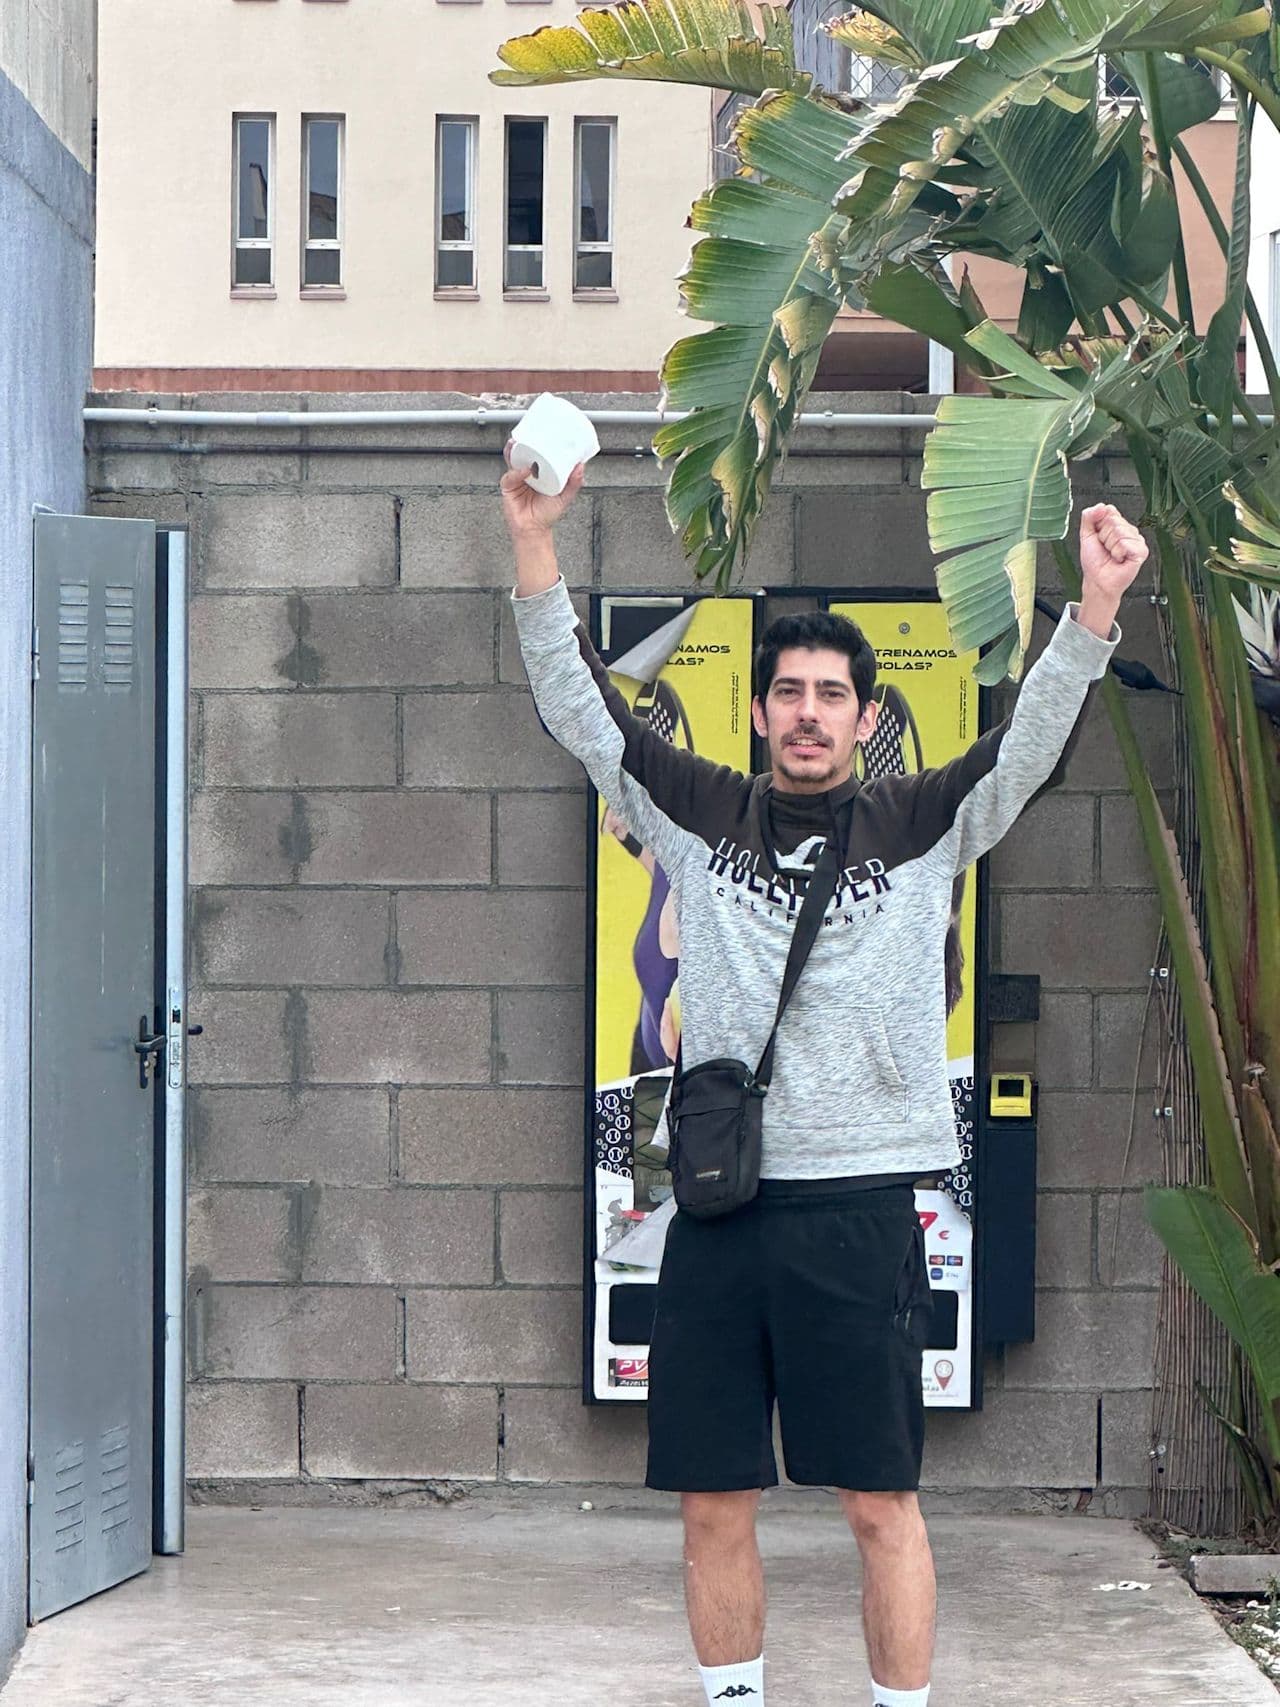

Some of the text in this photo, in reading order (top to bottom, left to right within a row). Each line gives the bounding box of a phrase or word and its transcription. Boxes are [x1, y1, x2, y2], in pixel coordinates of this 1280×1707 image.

[676, 644, 731, 654] NAMOS
[874, 648, 958, 658] TRENAMOS
[665, 657, 705, 666] LAS?
[707, 836, 892, 911] HOLLITER
[716, 887, 885, 927] CALIFRNIA
